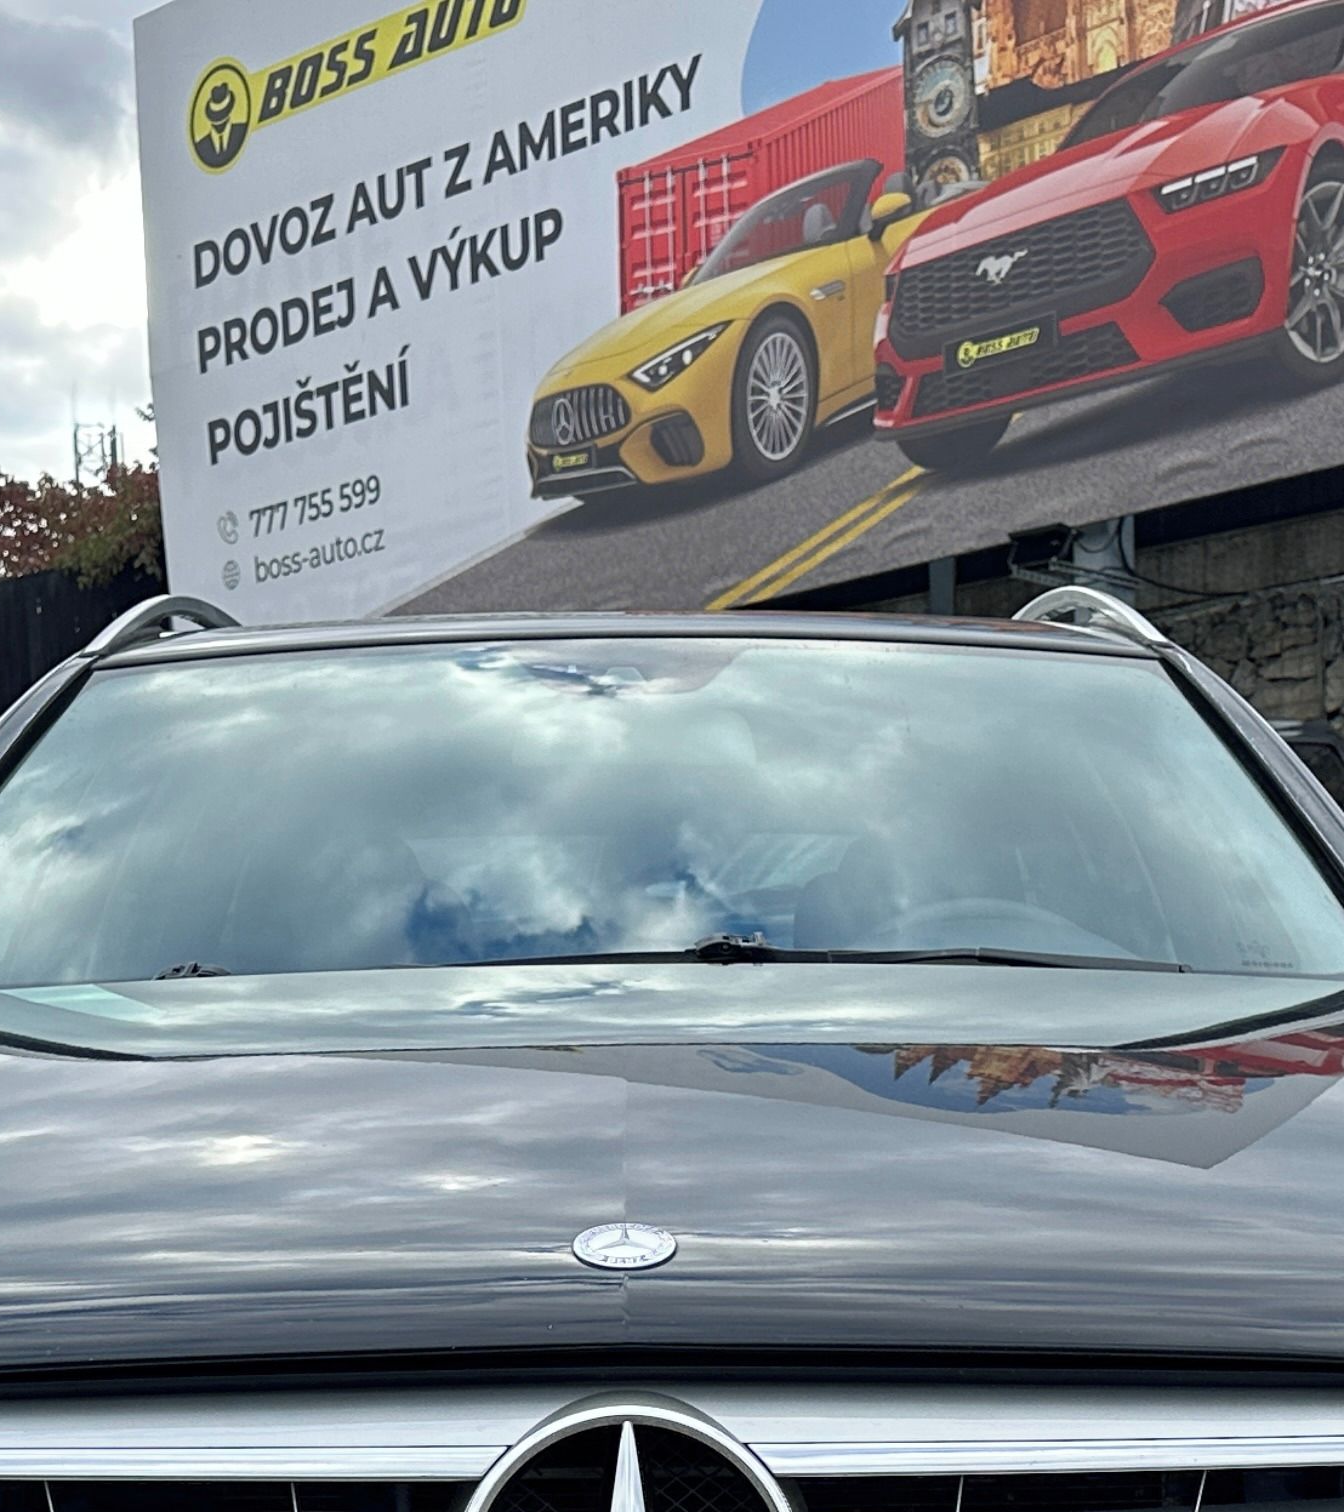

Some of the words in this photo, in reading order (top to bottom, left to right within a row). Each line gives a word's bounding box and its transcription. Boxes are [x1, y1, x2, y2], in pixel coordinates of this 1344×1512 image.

[258, 27, 378, 123] BOSS
[194, 194, 336, 289] DOVOZ
[346, 158, 433, 234] AUT
[444, 143, 472, 200] Z
[482, 54, 703, 184] AMERIKY
[197, 280, 355, 374] PRODEJ
[367, 267, 400, 319] A
[408, 208, 563, 301] VÝKUP
[207, 345, 411, 466] POJIŠTĚNÍ
[249, 501, 291, 537] 777
[293, 488, 335, 525] 755
[339, 475, 381, 513] 599
[255, 527, 386, 583] boss-auto.cz
